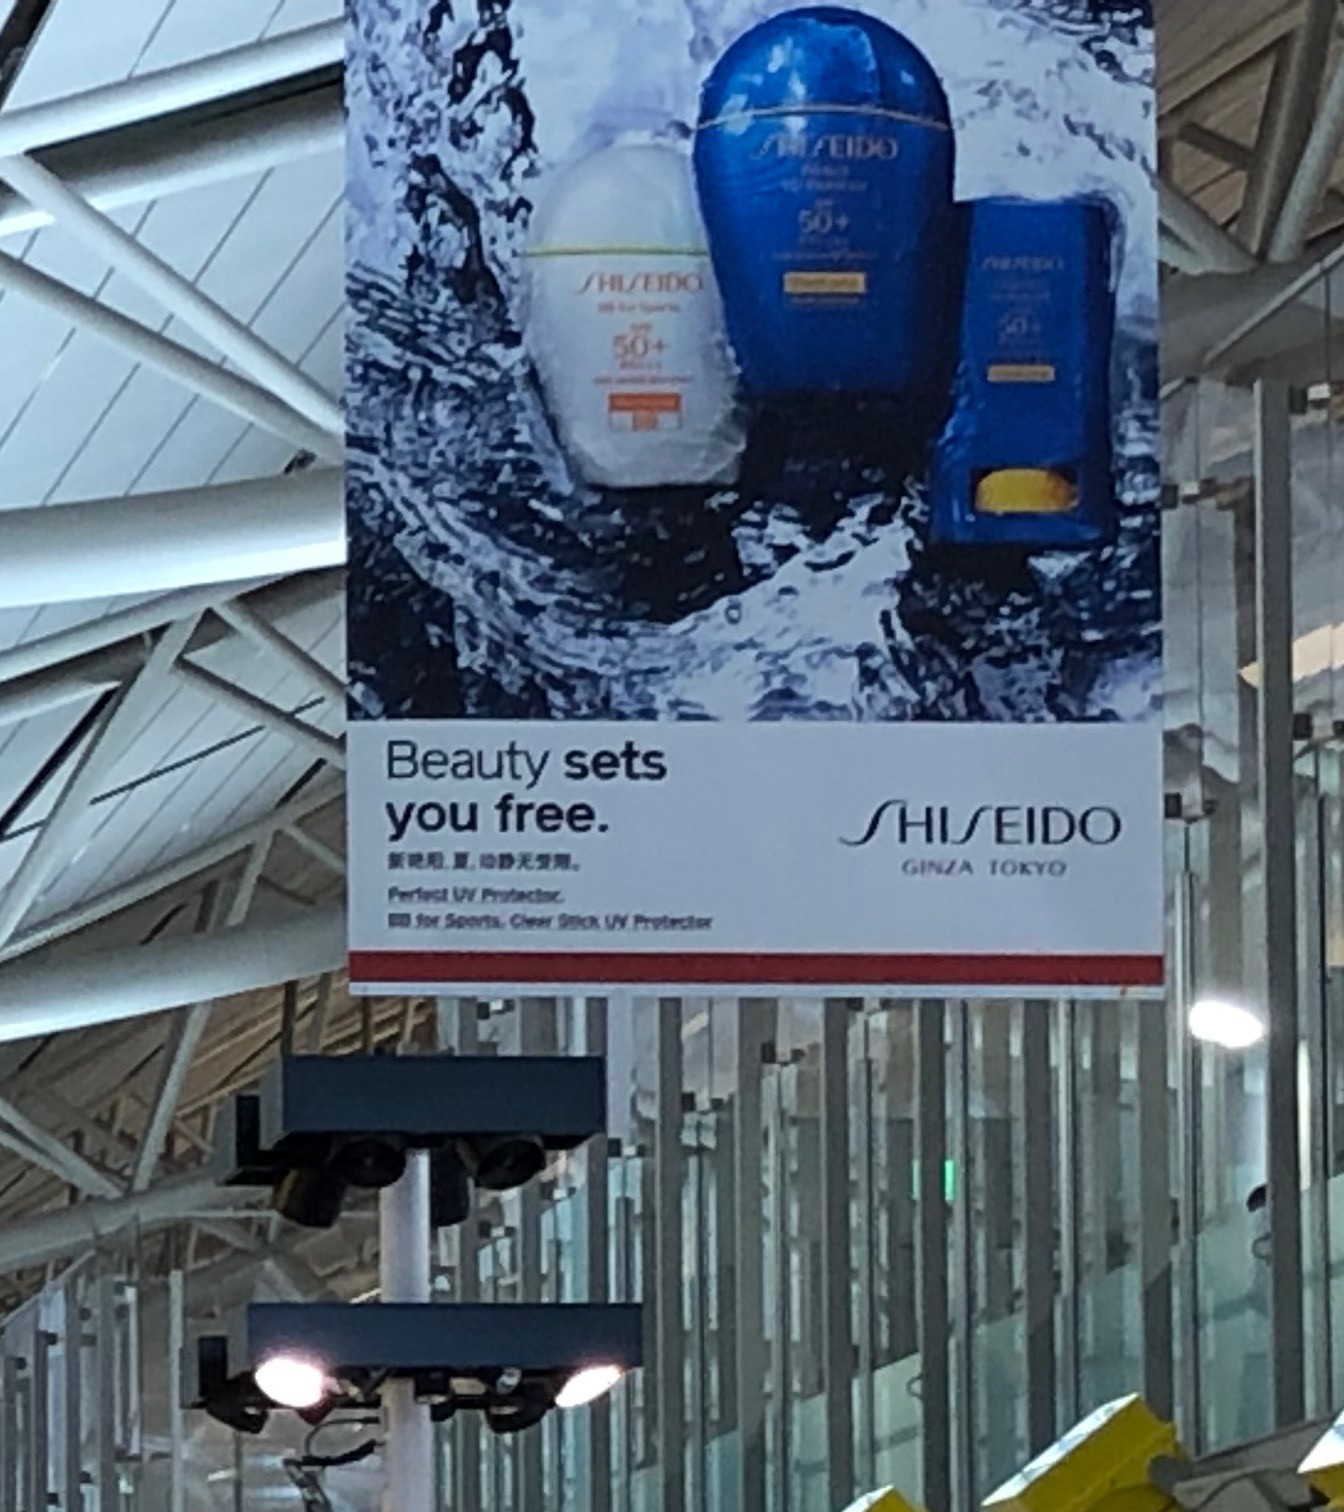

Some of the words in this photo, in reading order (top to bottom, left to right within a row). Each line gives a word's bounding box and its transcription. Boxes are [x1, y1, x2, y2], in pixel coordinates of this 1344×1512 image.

[575, 271, 704, 295] SHISEIDO
[387, 740, 550, 790] Beauty
[564, 740, 667, 781] sets
[385, 802, 478, 842] you
[494, 793, 609, 833] free.
[838, 799, 1122, 846] SHISEIDO
[901, 859, 974, 877] GINZA
[989, 859, 1068, 877] TOKYO
[387, 886, 449, 903] Perfect
[452, 887, 478, 903] UV
[416, 913, 440, 929] for
[510, 913, 553, 929] Clear
[558, 913, 599, 930] Stick
[605, 914, 629, 930] UV
[633, 914, 714, 931] Protector
